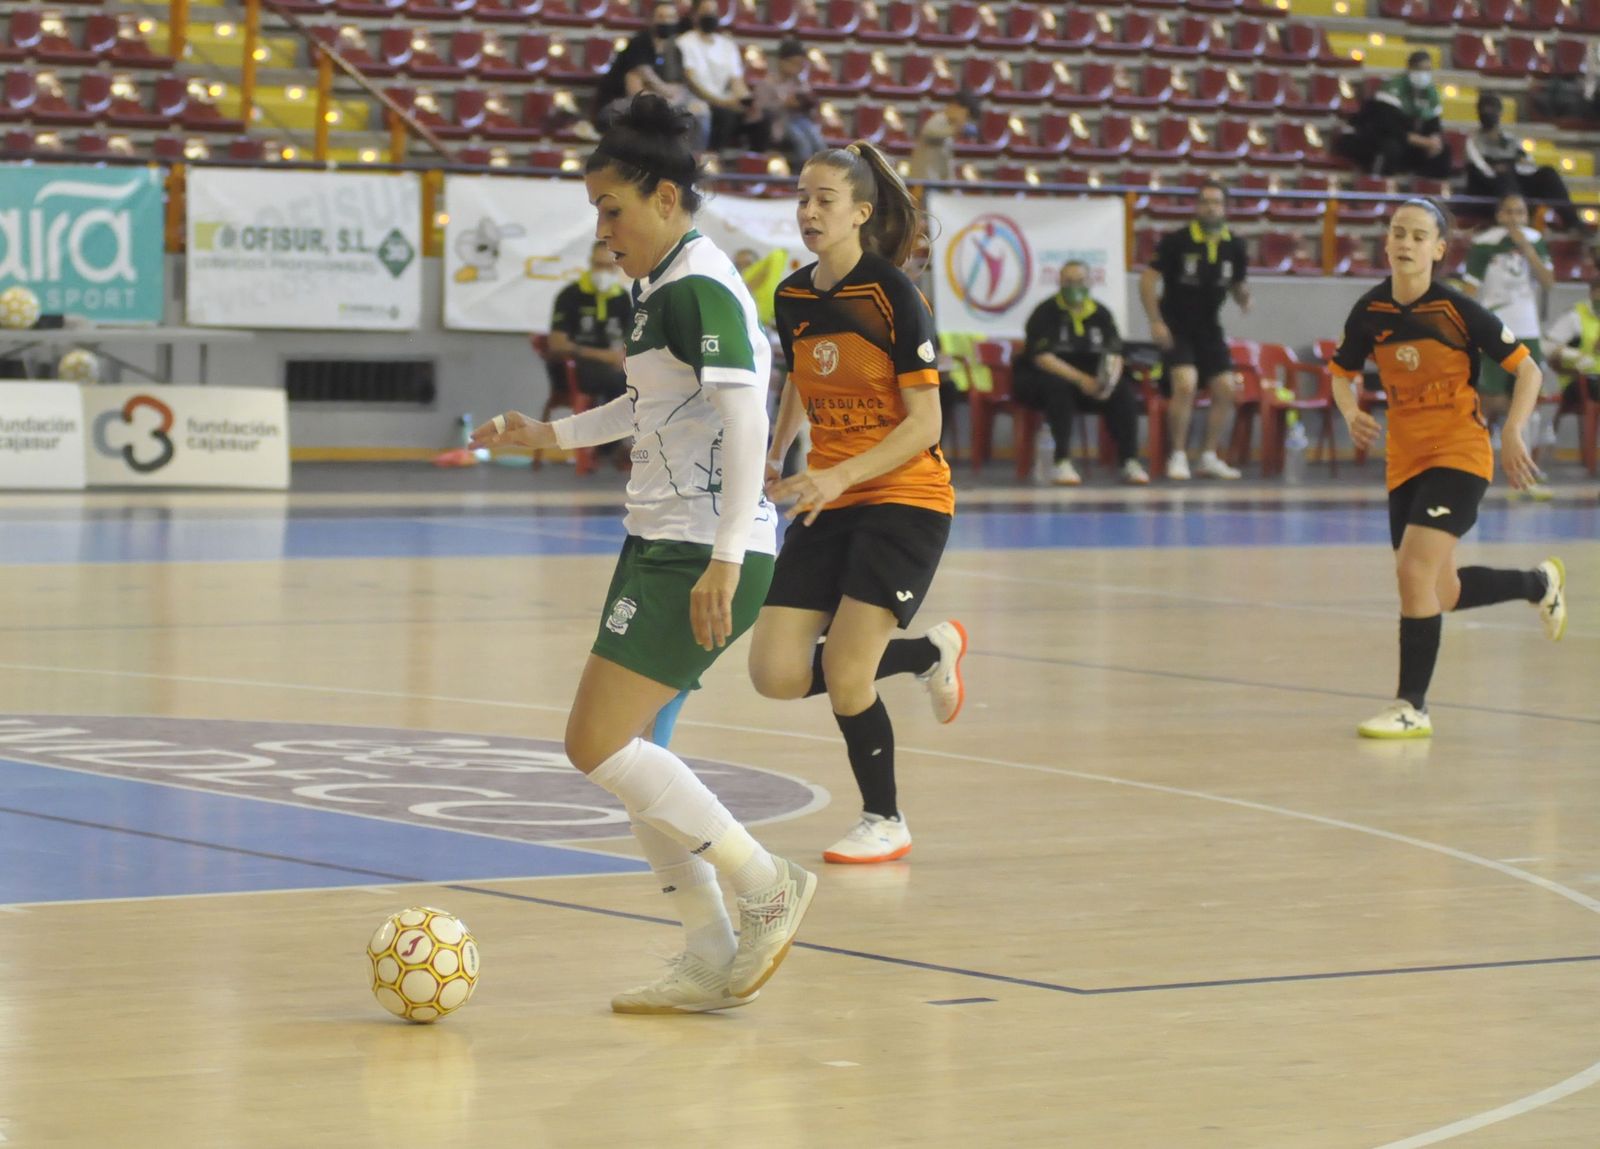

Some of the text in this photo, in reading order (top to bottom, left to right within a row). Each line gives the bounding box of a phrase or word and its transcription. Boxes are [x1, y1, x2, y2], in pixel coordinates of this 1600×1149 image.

[46, 288, 136, 309] SPORT
[187, 416, 279, 436] fundación
[187, 437, 261, 454] cajasur
